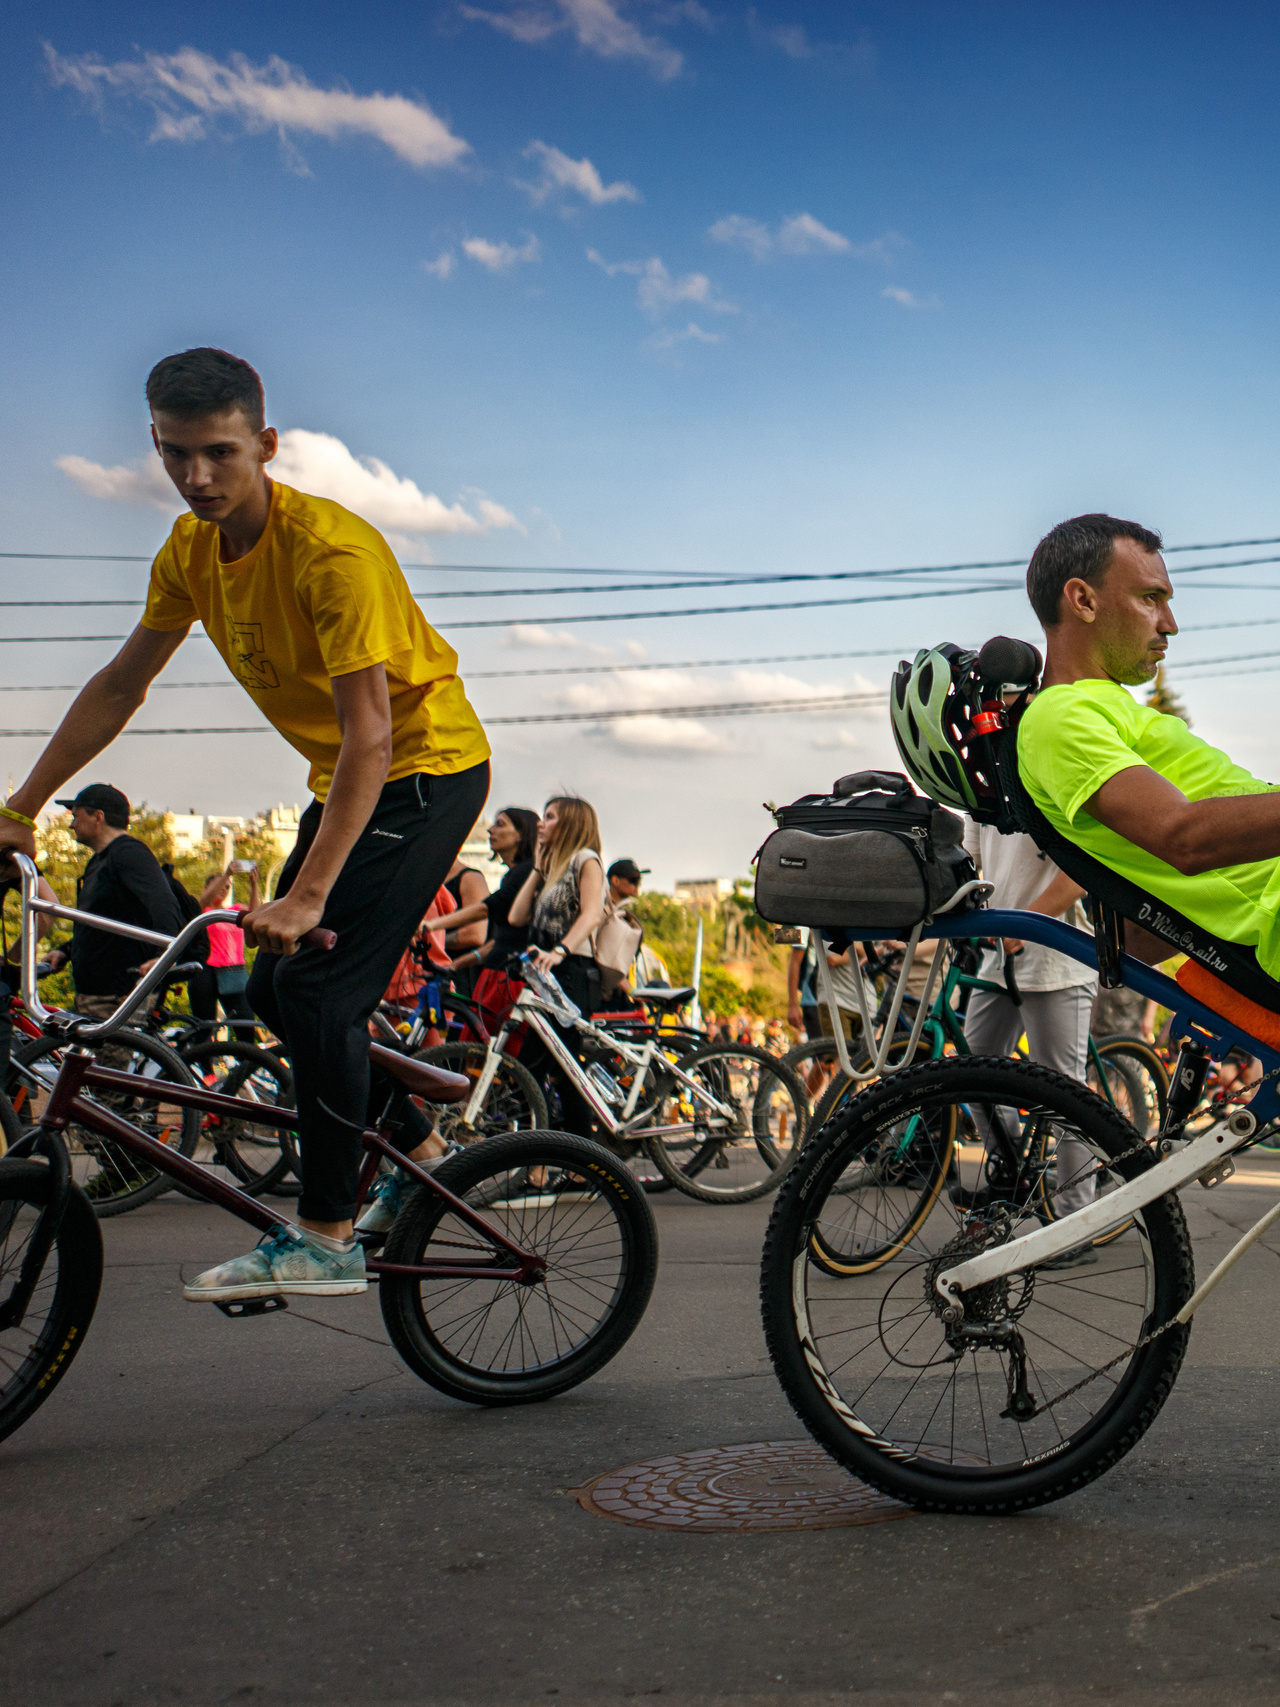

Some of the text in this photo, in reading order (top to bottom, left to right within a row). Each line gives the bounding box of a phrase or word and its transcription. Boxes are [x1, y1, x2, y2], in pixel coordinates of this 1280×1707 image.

[875, 1105, 923, 1133] ALEXRIMS
[799, 1082, 945, 1201] SCHWALBE BLACK JACK
[587, 1163, 630, 1201] MAXXIS
[36, 1325, 79, 1391] MAXXIS
[1021, 1440, 1071, 1467] ALEXRIMS
